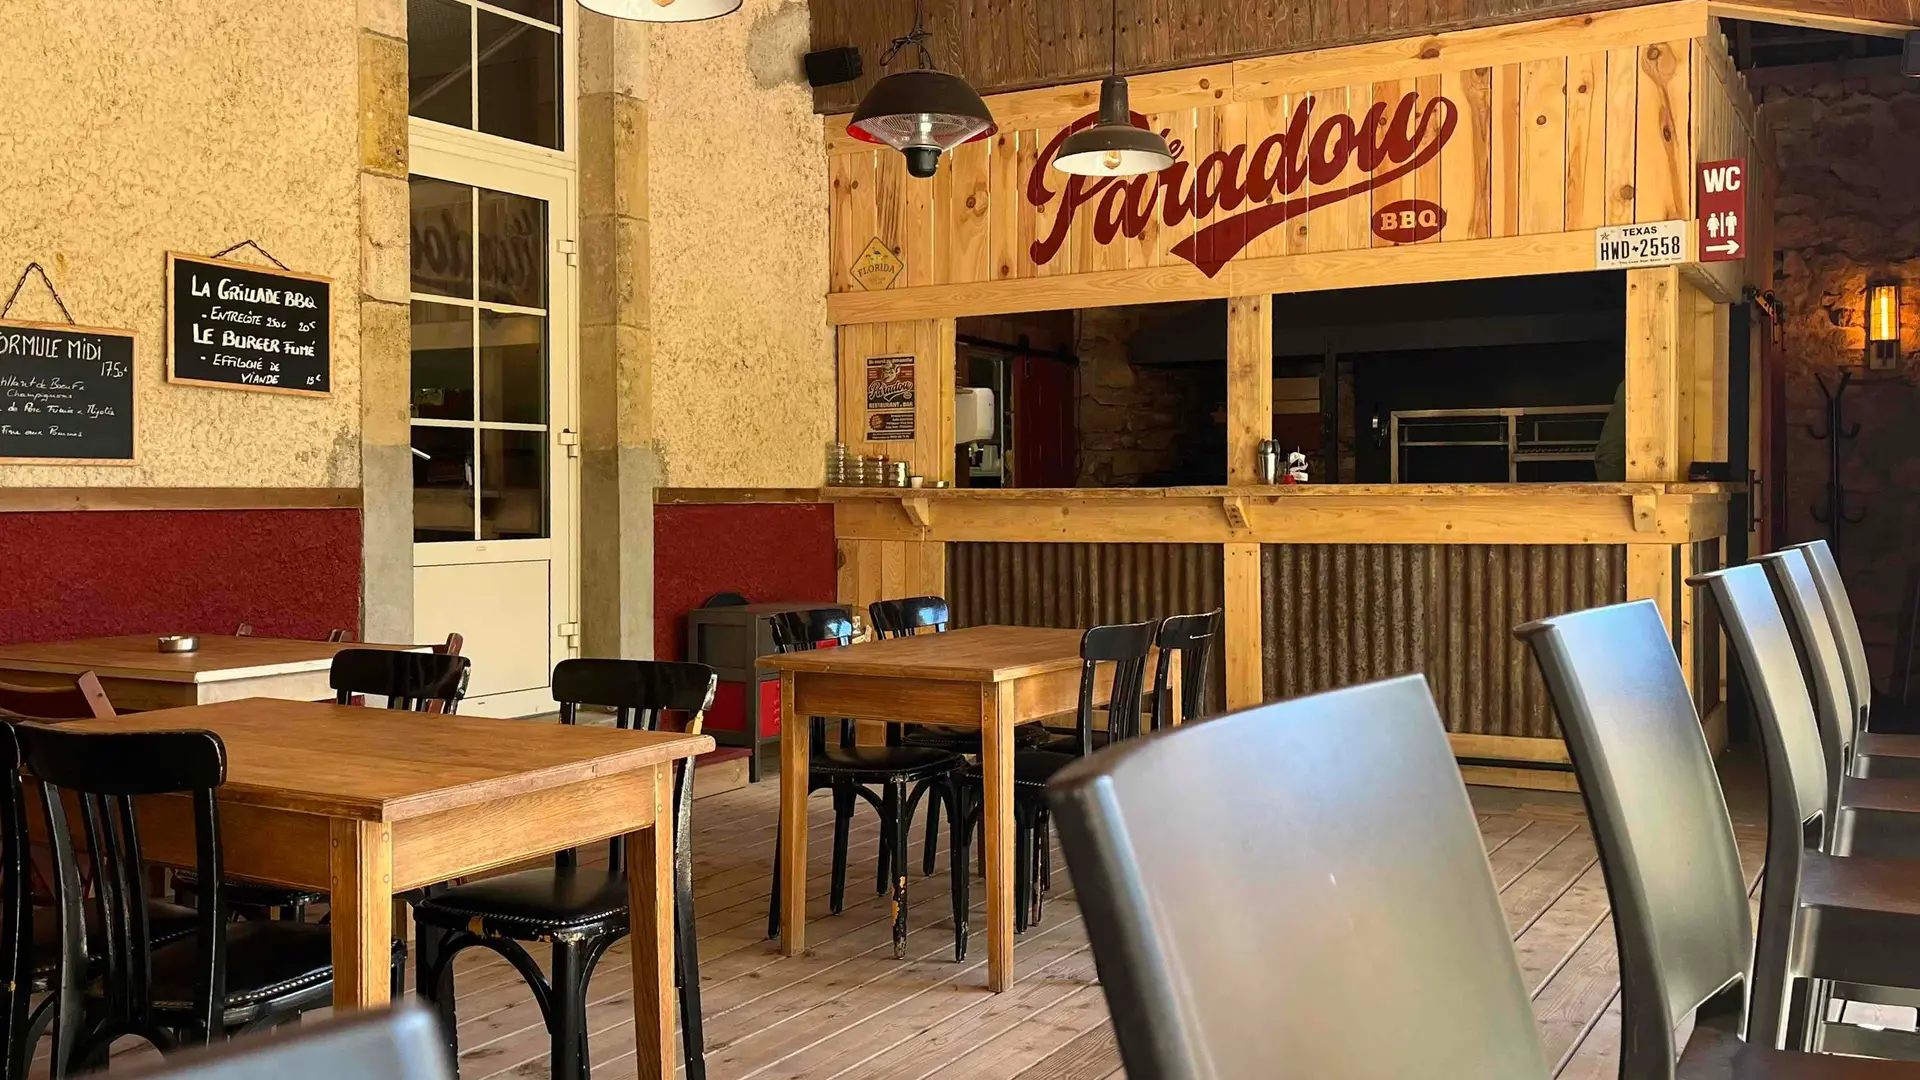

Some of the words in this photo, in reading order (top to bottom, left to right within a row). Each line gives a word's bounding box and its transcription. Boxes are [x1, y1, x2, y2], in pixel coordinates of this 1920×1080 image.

[1027, 91, 1458, 265] Paradou
[1703, 166, 1741, 193] WC
[1380, 211, 1438, 231] BBQ
[1622, 226, 1658, 237] TEXAS
[857, 263, 895, 277] FLORIDA
[191, 274, 211, 298] LA
[284, 291, 318, 309] BBQ
[192, 323, 215, 345] LE
[222, 330, 281, 353] BURGER
[269, 361, 281, 372] DE
